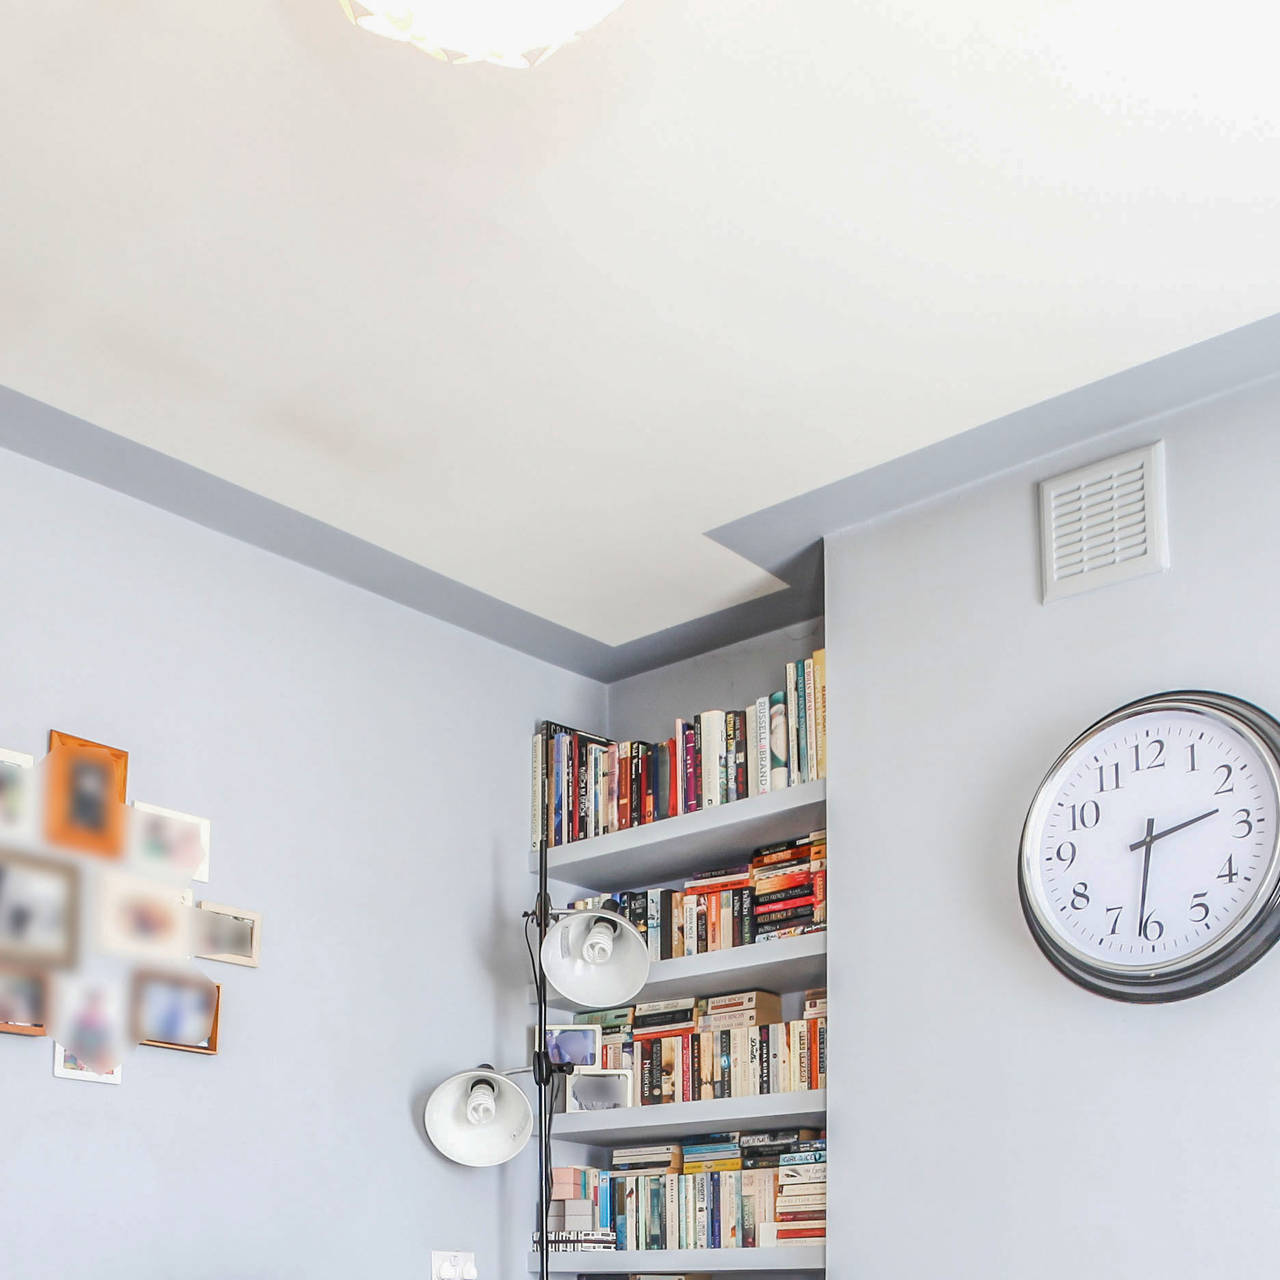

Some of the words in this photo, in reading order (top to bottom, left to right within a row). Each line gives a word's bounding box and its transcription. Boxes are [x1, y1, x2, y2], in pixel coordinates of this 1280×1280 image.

[758, 701, 769, 743] RUSSELL
[759, 750, 769, 786] BRAND
[1131, 739, 1166, 774] 12
[1184, 742, 1200, 774] 1
[1094, 761, 1124, 794] 11
[1213, 763, 1234, 795] 2
[1067, 800, 1101, 832] 10
[1231, 808, 1254, 839] 3
[1055, 840, 1077, 873] 9
[1216, 853, 1238, 885] 4
[1070, 881, 1090, 911] 8
[1189, 891, 1209, 923] 5
[1105, 905, 1124, 936] 7
[1142, 908, 1165, 942] 6
[643, 1059, 651, 1097] Historian
